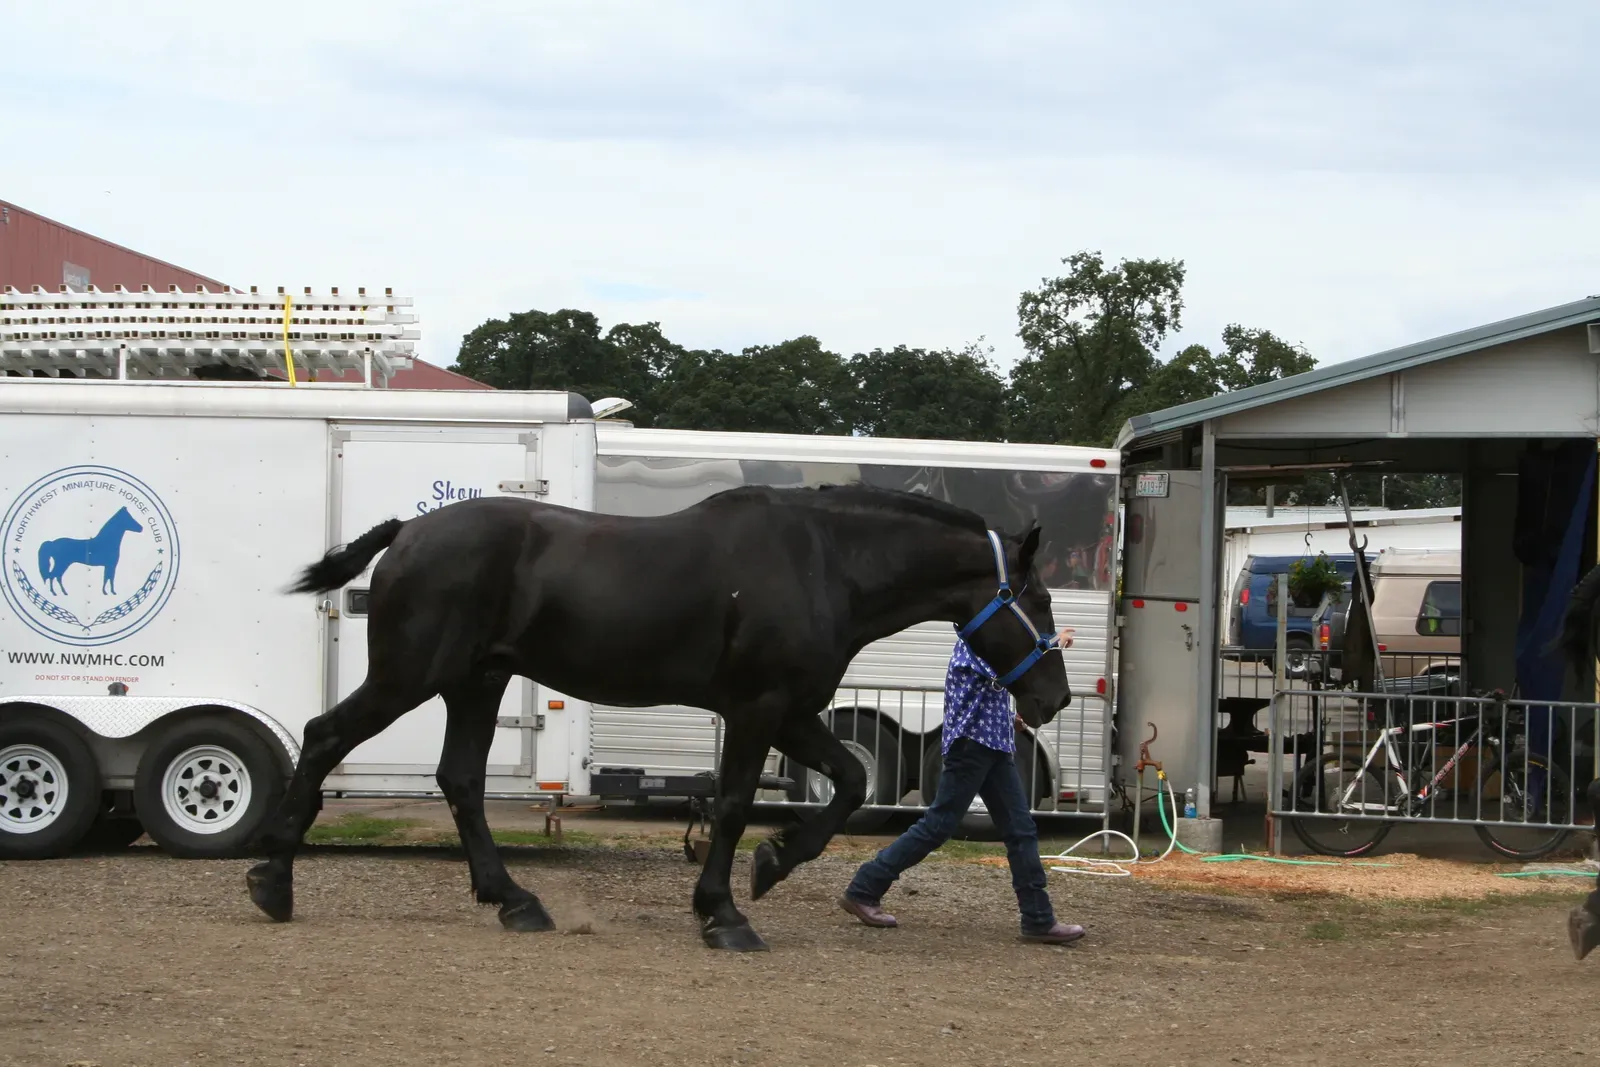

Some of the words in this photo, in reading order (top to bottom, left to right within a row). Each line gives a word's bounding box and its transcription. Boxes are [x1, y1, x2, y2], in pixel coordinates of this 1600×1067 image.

[432, 480, 482, 500] Show
[15, 488, 58, 542] NORTHWEST
[62, 480, 116, 492] MINIATURE
[119, 488, 150, 515] HORSE
[147, 516, 163, 543] CLUB
[8, 652, 165, 667] WWW.NWMHC.COM
